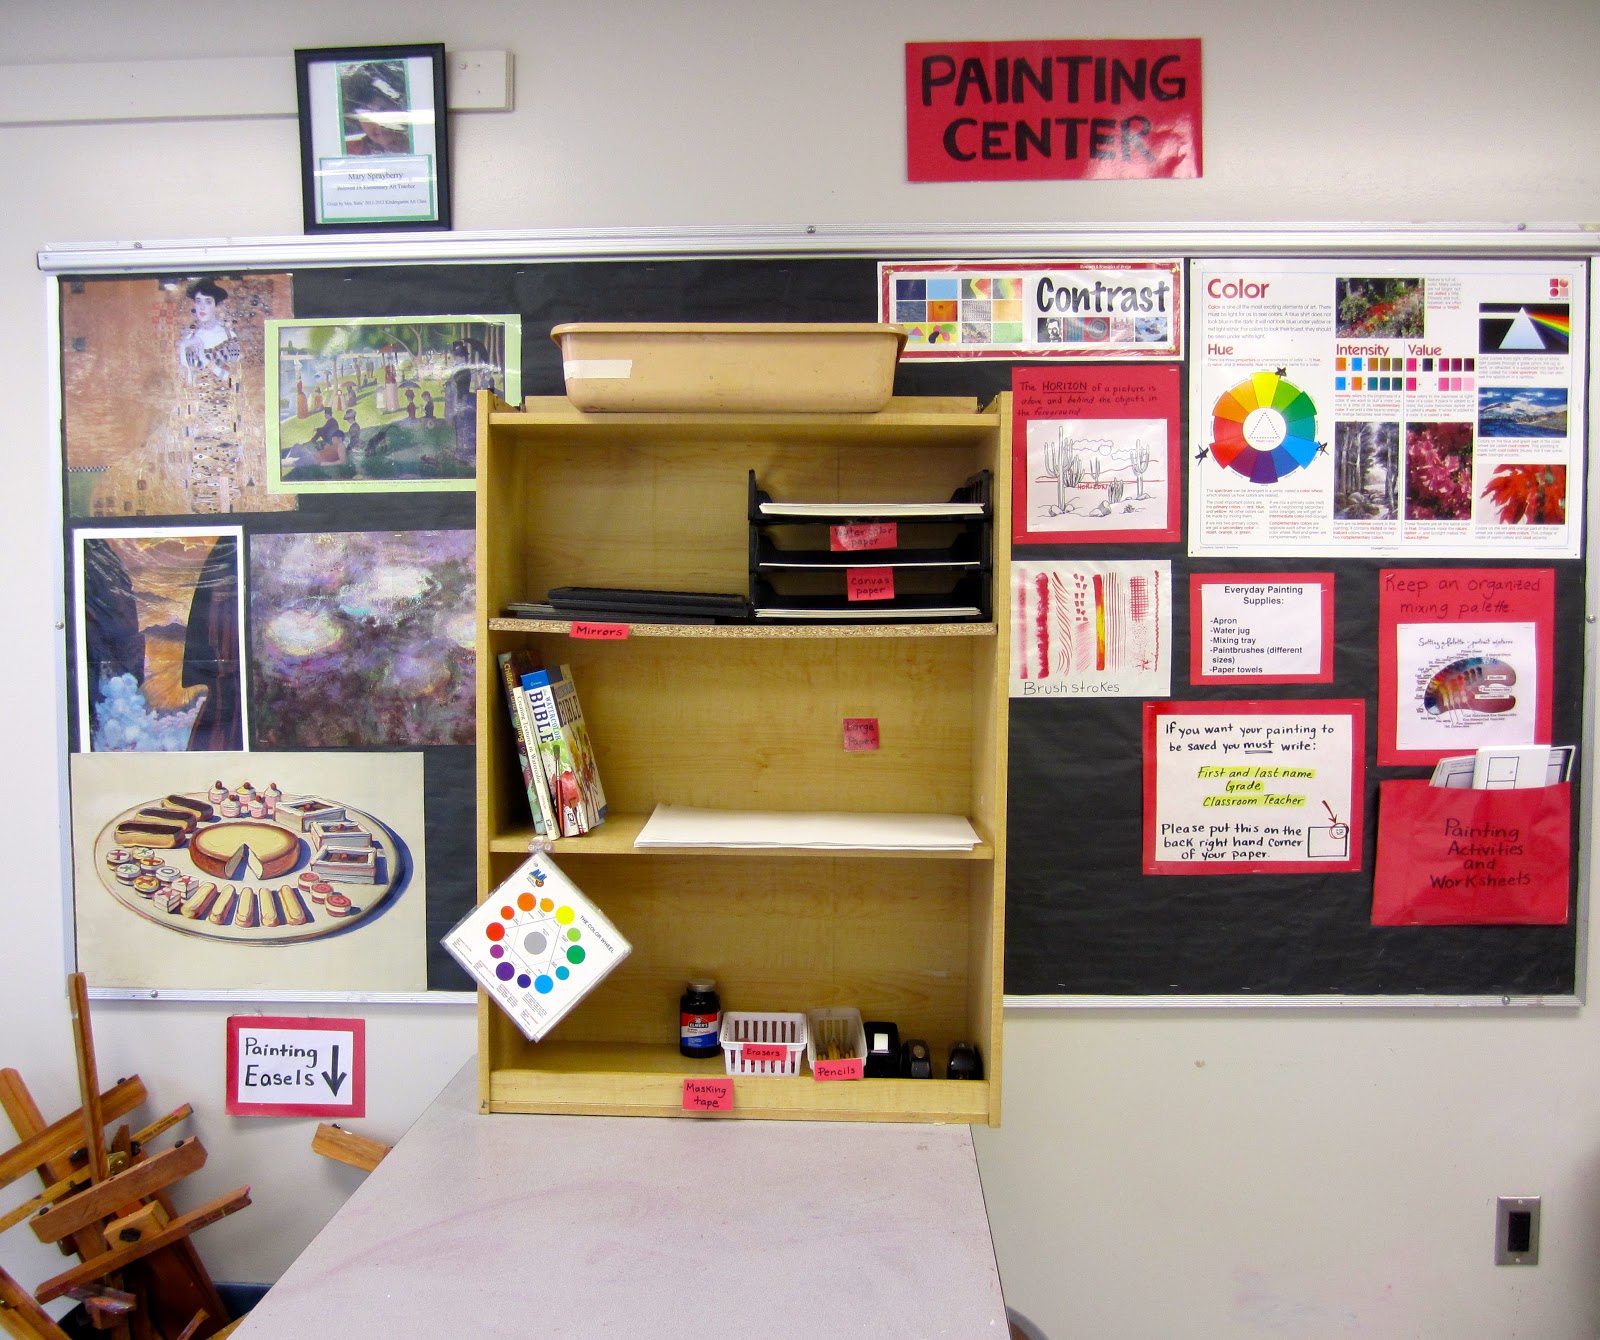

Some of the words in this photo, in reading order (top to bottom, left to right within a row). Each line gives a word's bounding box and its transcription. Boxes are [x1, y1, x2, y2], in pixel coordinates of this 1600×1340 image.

[922, 55, 1186, 106] PAINTING
[943, 116, 1156, 162] CENTER
[1036, 277, 1170, 312] Contrast
[1208, 278, 1270, 299] Color
[1208, 344, 1234, 355] Hue
[1336, 344, 1389, 356] Intensity
[1408, 344, 1442, 356] Value
[1019, 382, 1036, 391] The
[1042, 382, 1087, 391] HORIZON
[1092, 383, 1102, 391] of
[1112, 384, 1144, 396] picture
[1047, 396, 1062, 404] and
[1067, 396, 1094, 404] behind
[1115, 394, 1145, 405] objects
[1034, 408, 1081, 417] foreground
[852, 539, 879, 548] paper
[857, 588, 885, 598] paper
[1224, 586, 1264, 595] Everyday
[1267, 586, 1303, 595] Painting
[1385, 577, 1428, 597] Keep
[1438, 580, 1459, 591] an
[1467, 578, 1540, 599] organized
[1243, 597, 1284, 605] Supplies:
[1400, 602, 1448, 619] mixing
[1459, 600, 1514, 619] palette.
[576, 626, 622, 636] Mirrors
[1237, 627, 1250, 635] jug
[1210, 637, 1239, 645] -Mixing
[1241, 637, 1256, 645] tray
[1266, 646, 1302, 654] (different
[1023, 681, 1068, 695] Brush
[529, 690, 554, 744] BIBLE
[546, 696, 561, 740] WATERCOLOR
[846, 722, 874, 734] Large
[1165, 722, 1176, 734] If
[1178, 727, 1200, 739] you
[1204, 723, 1233, 733] want
[1239, 726, 1263, 738] your
[1266, 724, 1316, 739] painting
[1321, 724, 1334, 734] to
[1170, 742, 1182, 751] be
[1188, 740, 1216, 750] saved
[1222, 743, 1240, 754] you
[1243, 740, 1274, 749] must
[1281, 740, 1316, 751] write:
[1197, 766, 1226, 779] First
[1229, 768, 1250, 778] and
[1254, 767, 1279, 778] last
[1282, 770, 1313, 778] name
[1225, 780, 1261, 793] Grade
[1203, 796, 1257, 806] Classroom
[1264, 794, 1304, 805] Teacher
[1161, 823, 1205, 835] Please
[1210, 824, 1231, 837] put
[1234, 824, 1259, 833] this
[1282, 826, 1302, 836] the
[1444, 818, 1519, 842] Painting
[1199, 837, 1228, 851] right
[1232, 837, 1263, 847] hand
[1268, 838, 1303, 847] corner
[1448, 840, 1523, 856] Activities
[1181, 849, 1196, 860] of
[1201, 851, 1226, 861] your
[1232, 850, 1270, 860] paper.
[1464, 858, 1496, 870] and
[580, 915, 589, 924] THE
[588, 924, 601, 939] COLOR
[601, 938, 614, 954] WHEEL
[245, 1037, 318, 1068] Painting
[746, 1048, 780, 1057] Erasers
[244, 1064, 314, 1086] Easels
[818, 1066, 856, 1076] Pencils
[694, 1096, 720, 1108] tape
